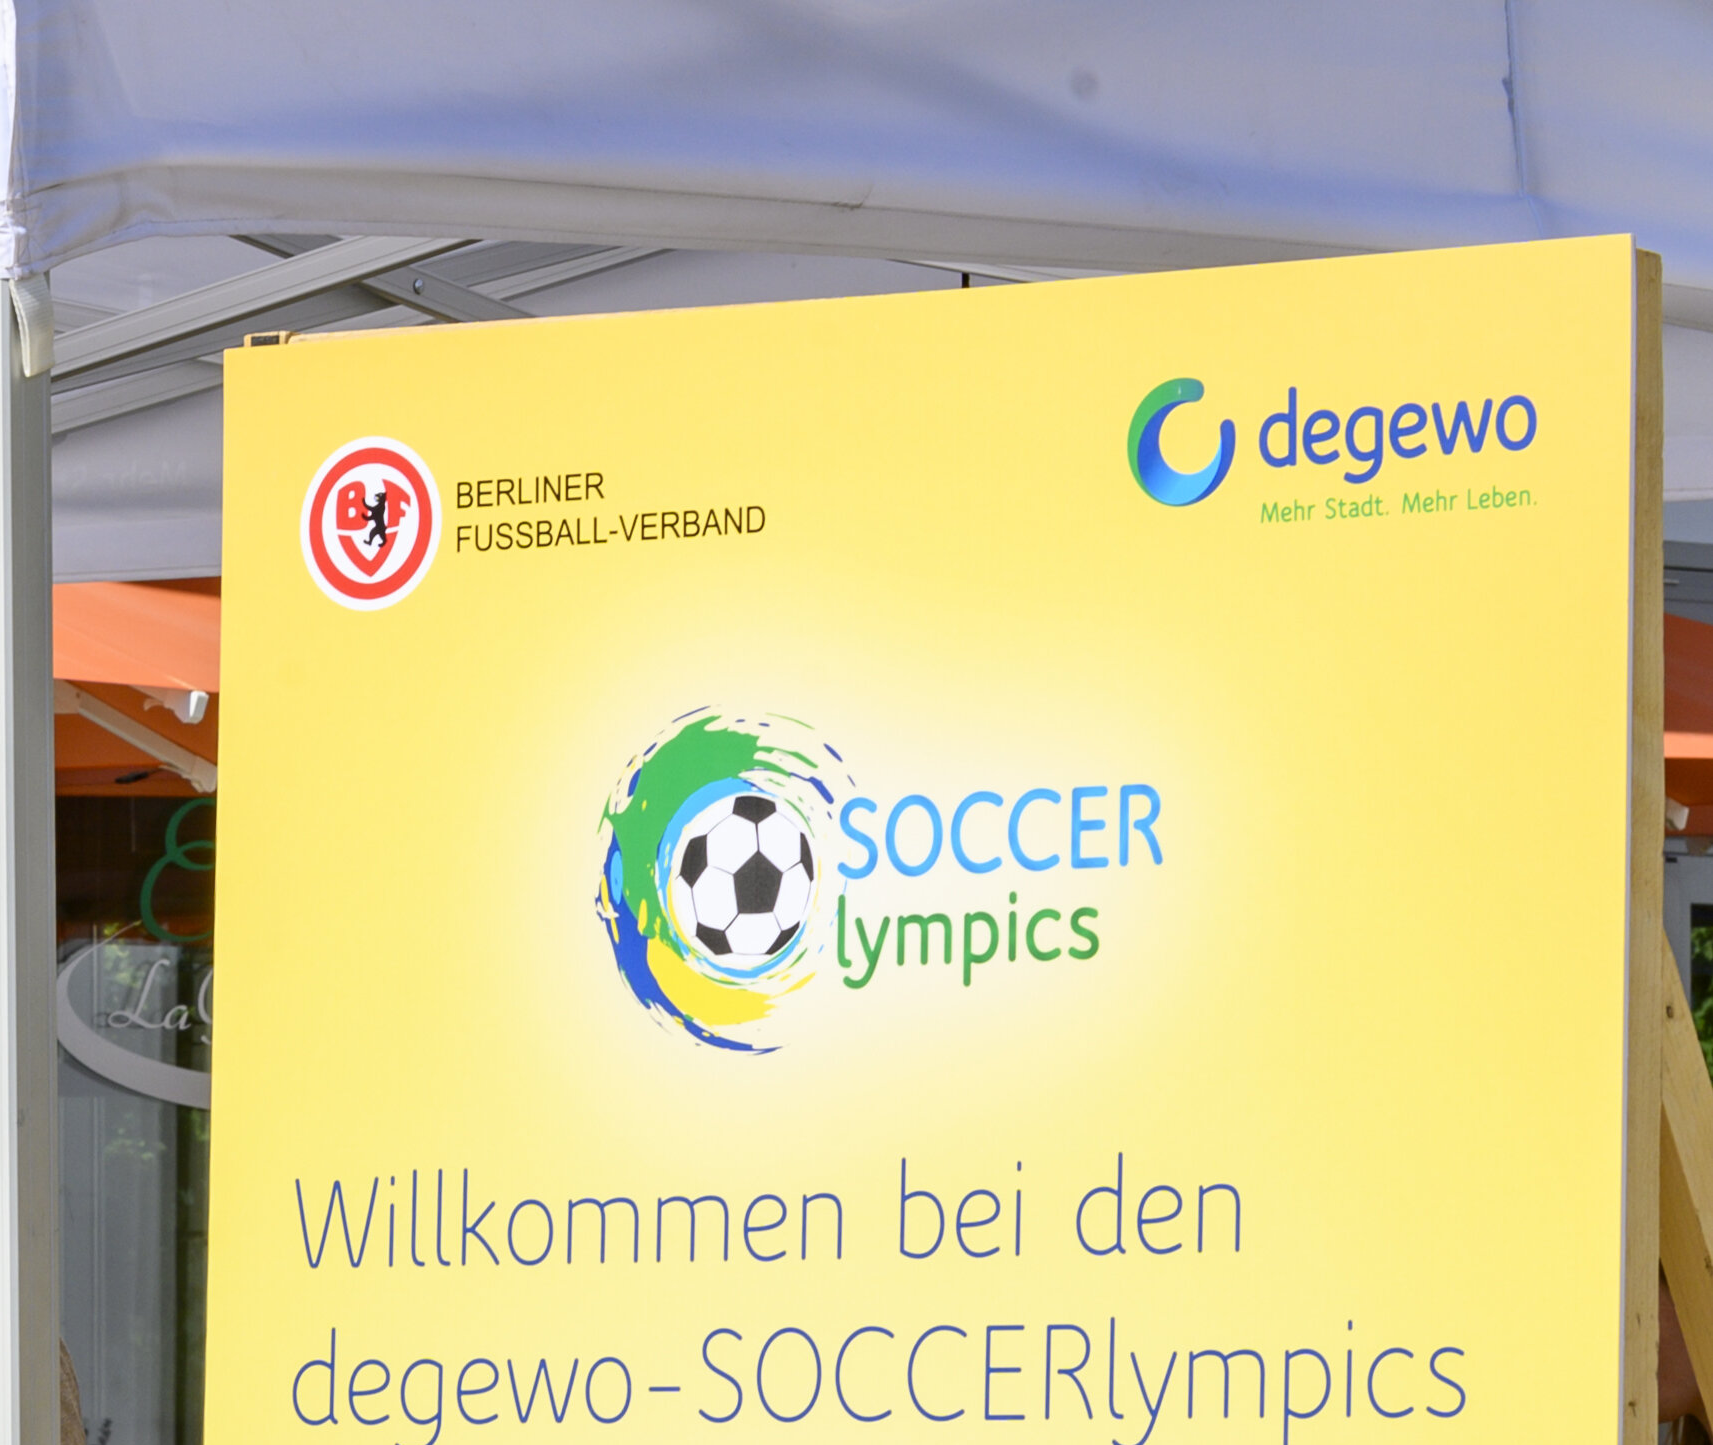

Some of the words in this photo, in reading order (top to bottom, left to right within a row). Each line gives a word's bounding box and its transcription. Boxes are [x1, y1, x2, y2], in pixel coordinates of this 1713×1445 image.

[1258, 386, 1538, 484] degewo
[456, 472, 605, 508] BERLINER
[456, 505, 767, 552] FUSSBALL-VERBAND
[1260, 498, 1315, 524] Mehr
[1325, 494, 1390, 520] Stadt.
[1401, 489, 1457, 515] Mehr
[1466, 485, 1538, 511] Leben.
[837, 784, 1163, 880] SOCCER
[837, 891, 1100, 989] lympics
[295, 1167, 845, 1269] Willkommen
[899, 1157, 1024, 1260] bei
[1075, 1151, 1242, 1257] den
